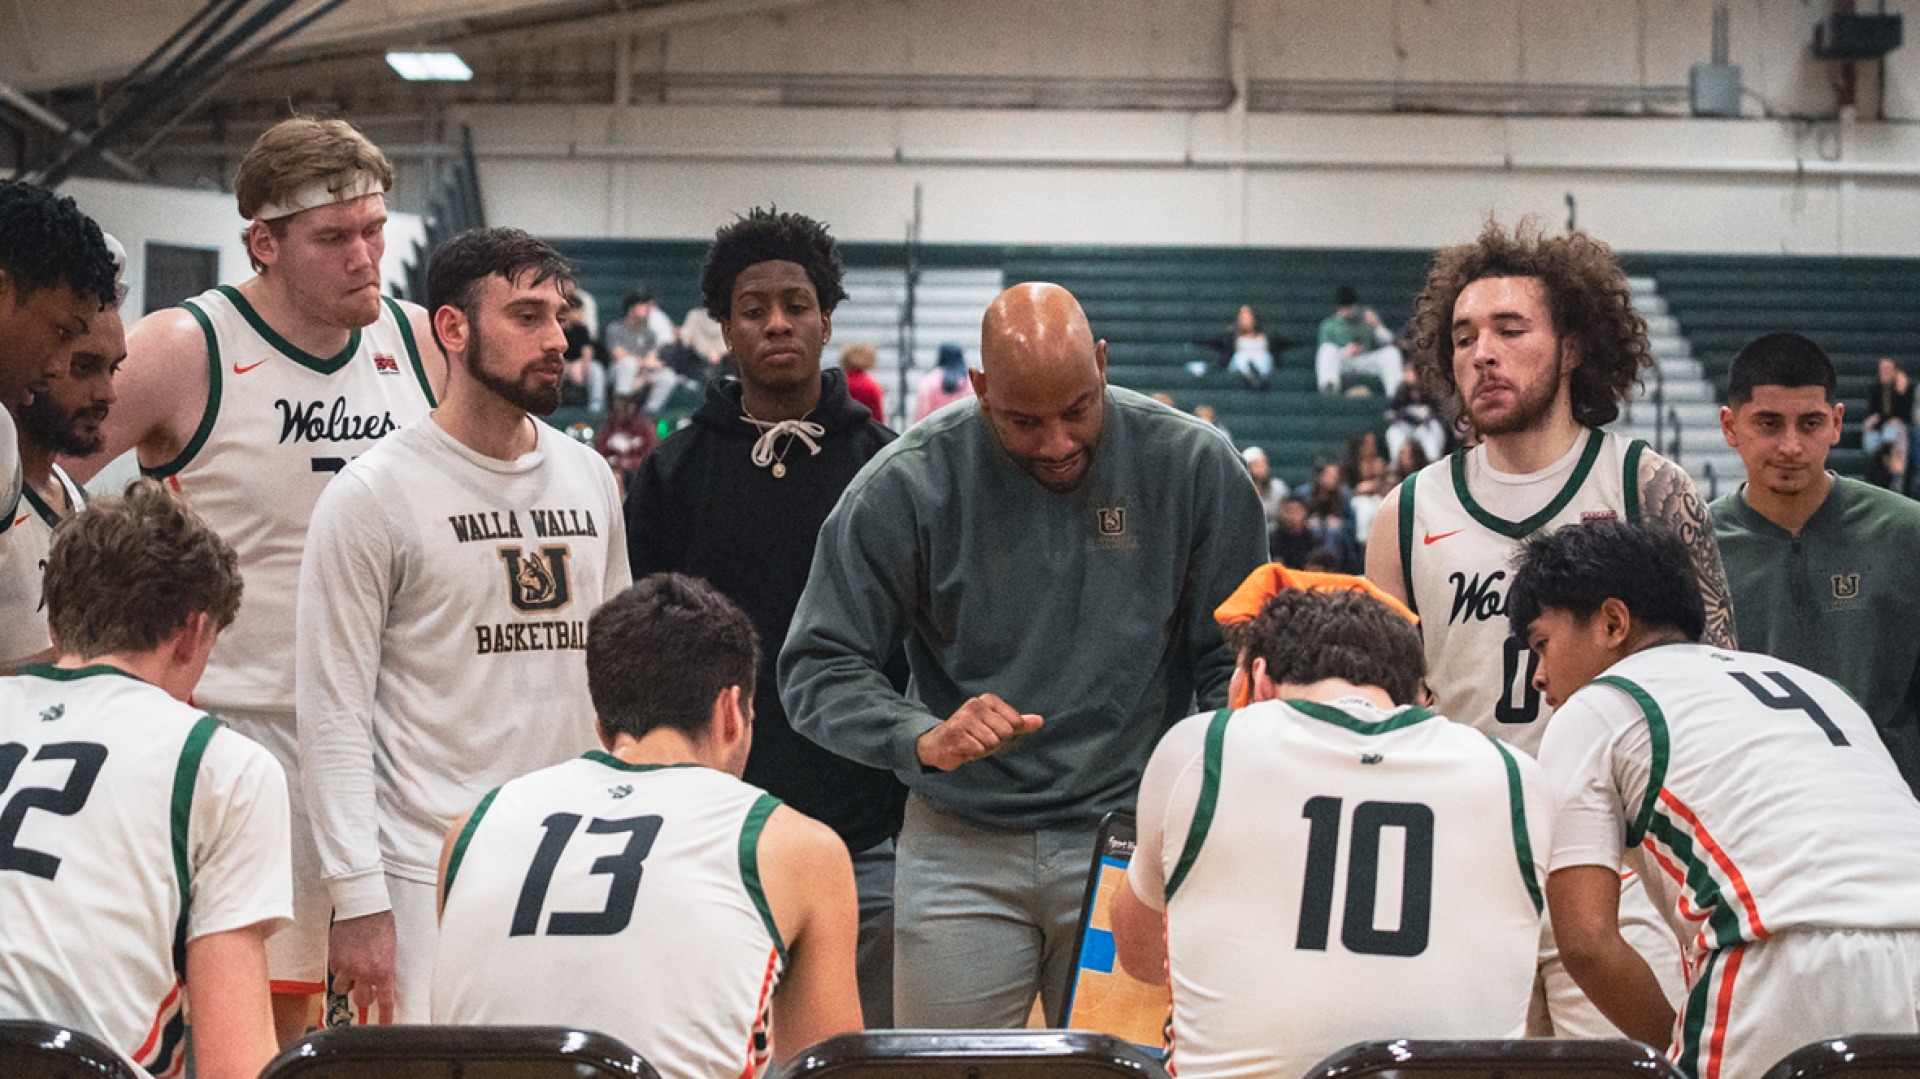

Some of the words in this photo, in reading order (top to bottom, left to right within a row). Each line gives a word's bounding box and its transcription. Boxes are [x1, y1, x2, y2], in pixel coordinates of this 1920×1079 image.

[275, 396, 397, 444] Wolves
[449, 510, 523, 543] WALLA
[530, 510, 598, 538] WALLA
[476, 621, 588, 655] BASKETBAL
[1495, 636, 1540, 724] 0
[1726, 671, 1851, 746] 4
[509, 811, 664, 937] 13
[1295, 795, 1434, 957] 10
